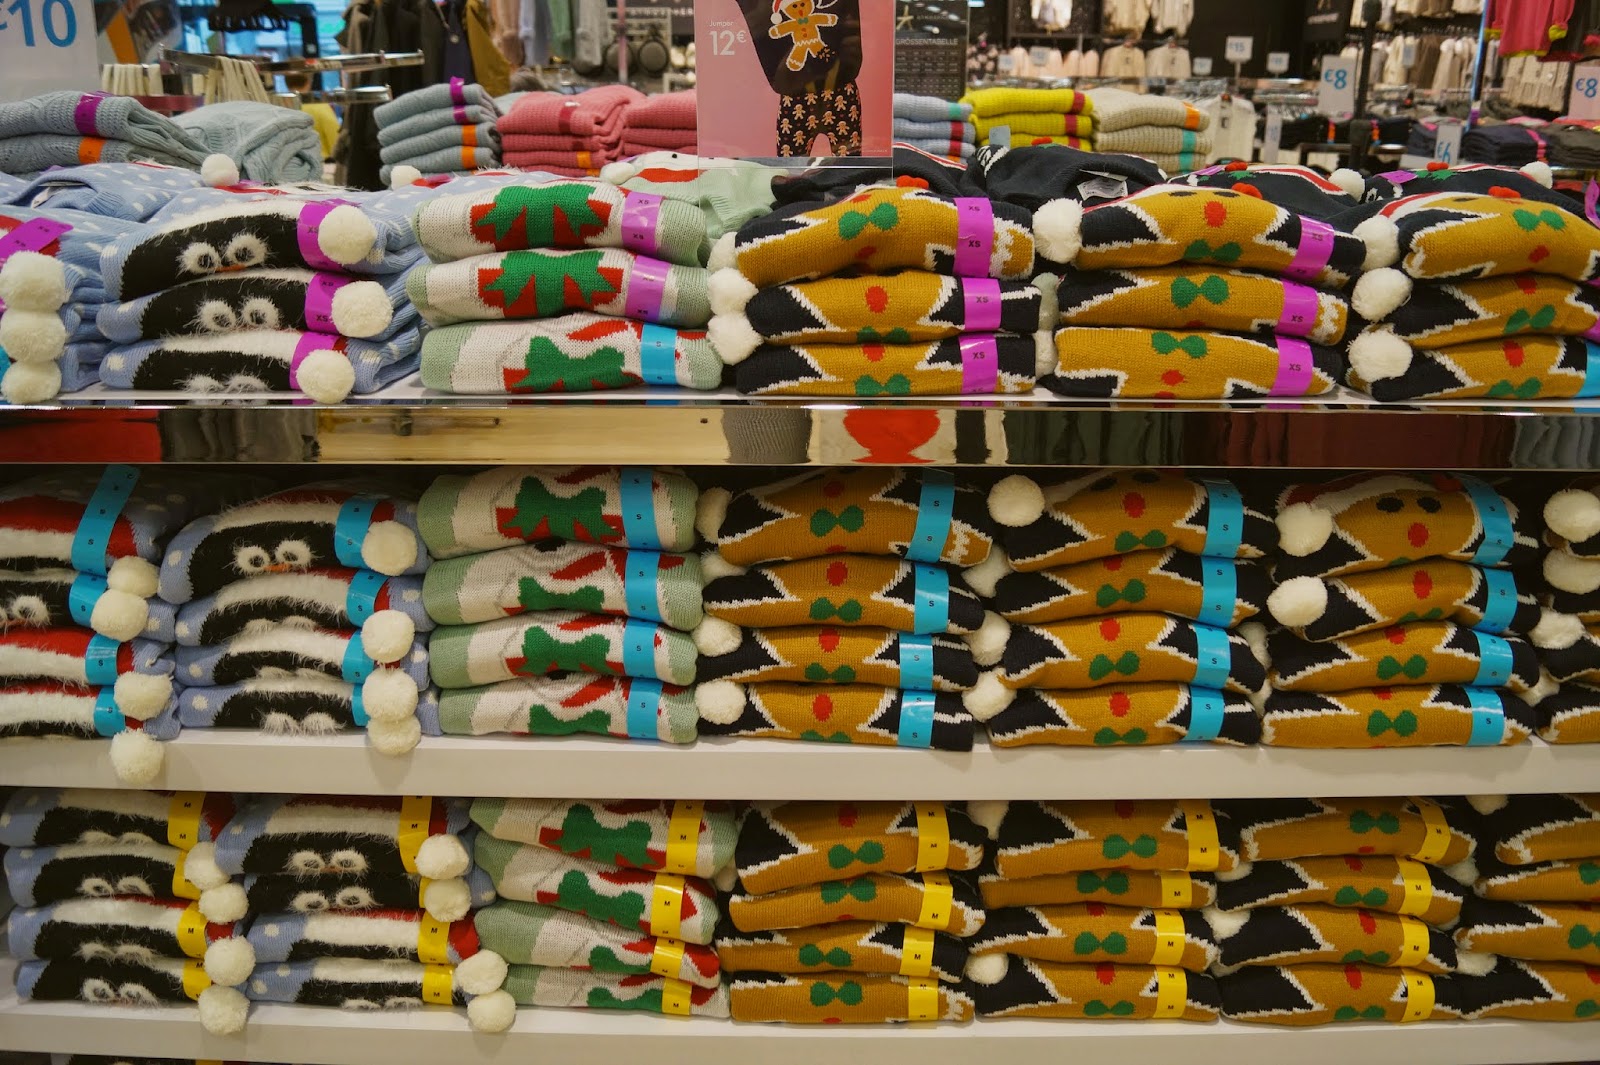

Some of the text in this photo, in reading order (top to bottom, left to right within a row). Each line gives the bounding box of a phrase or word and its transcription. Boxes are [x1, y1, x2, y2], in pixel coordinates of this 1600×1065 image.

[0, 0, 77, 47] 10
[709, 20, 734, 28] Jumper
[709, 29, 747, 56] 12€
[1324, 69, 1347, 90] €8
[1575, 77, 1598, 98] €8
[1311, 232, 1323, 242] XS
[968, 240, 981, 248] XS
[976, 296, 989, 304] XS
[316, 314, 328, 323] XS
[1291, 315, 1304, 323] XS
[656, 340, 662, 348] S
[973, 351, 985, 360] XS
[1289, 363, 1301, 372] XS
[1222, 524, 1229, 532] S
[357, 604, 363, 612] S
[98, 659, 104, 667] S
[915, 694, 922, 703] S
[107, 706, 113, 714] S
